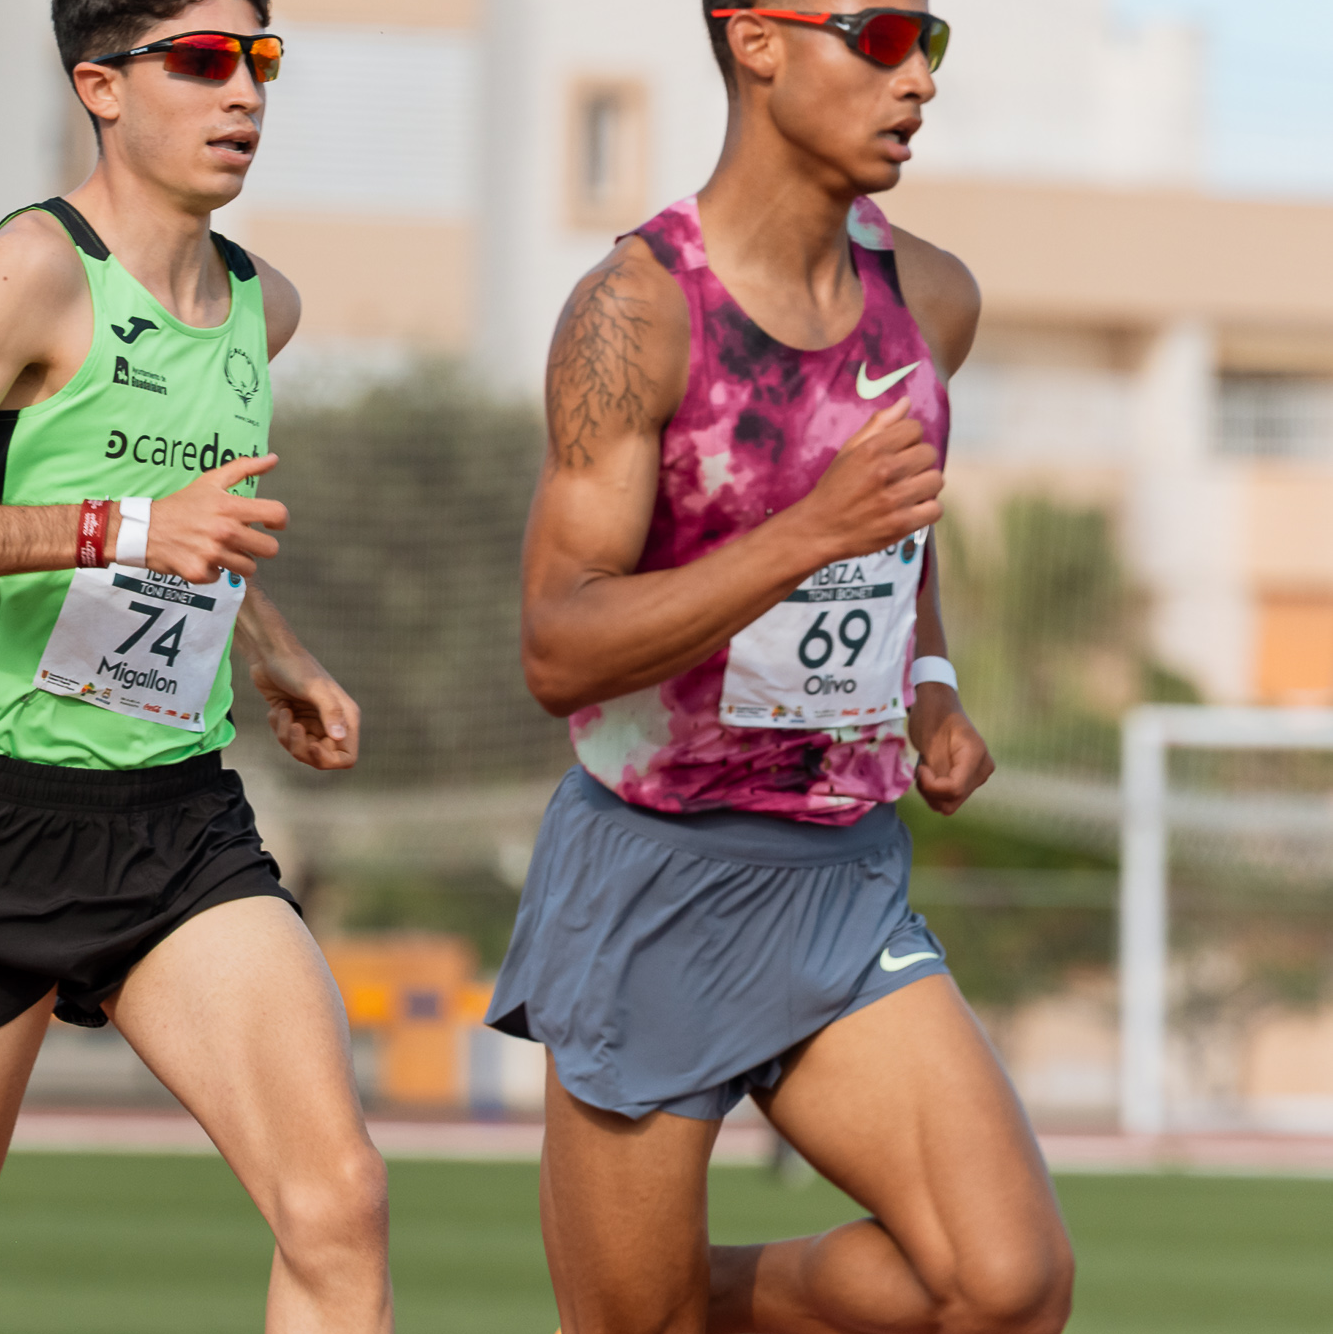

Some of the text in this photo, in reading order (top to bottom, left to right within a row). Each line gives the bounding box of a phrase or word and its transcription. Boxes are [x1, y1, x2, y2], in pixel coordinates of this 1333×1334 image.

[811, 563, 866, 586] IBIZA
[140, 582, 196, 604] TONI BONET
[808, 587, 875, 601] TONI BONET
[113, 600, 188, 667] 74
[798, 608, 872, 670] 69
[96, 656, 178, 695] Migallon
[804, 674, 857, 696] Olivo
